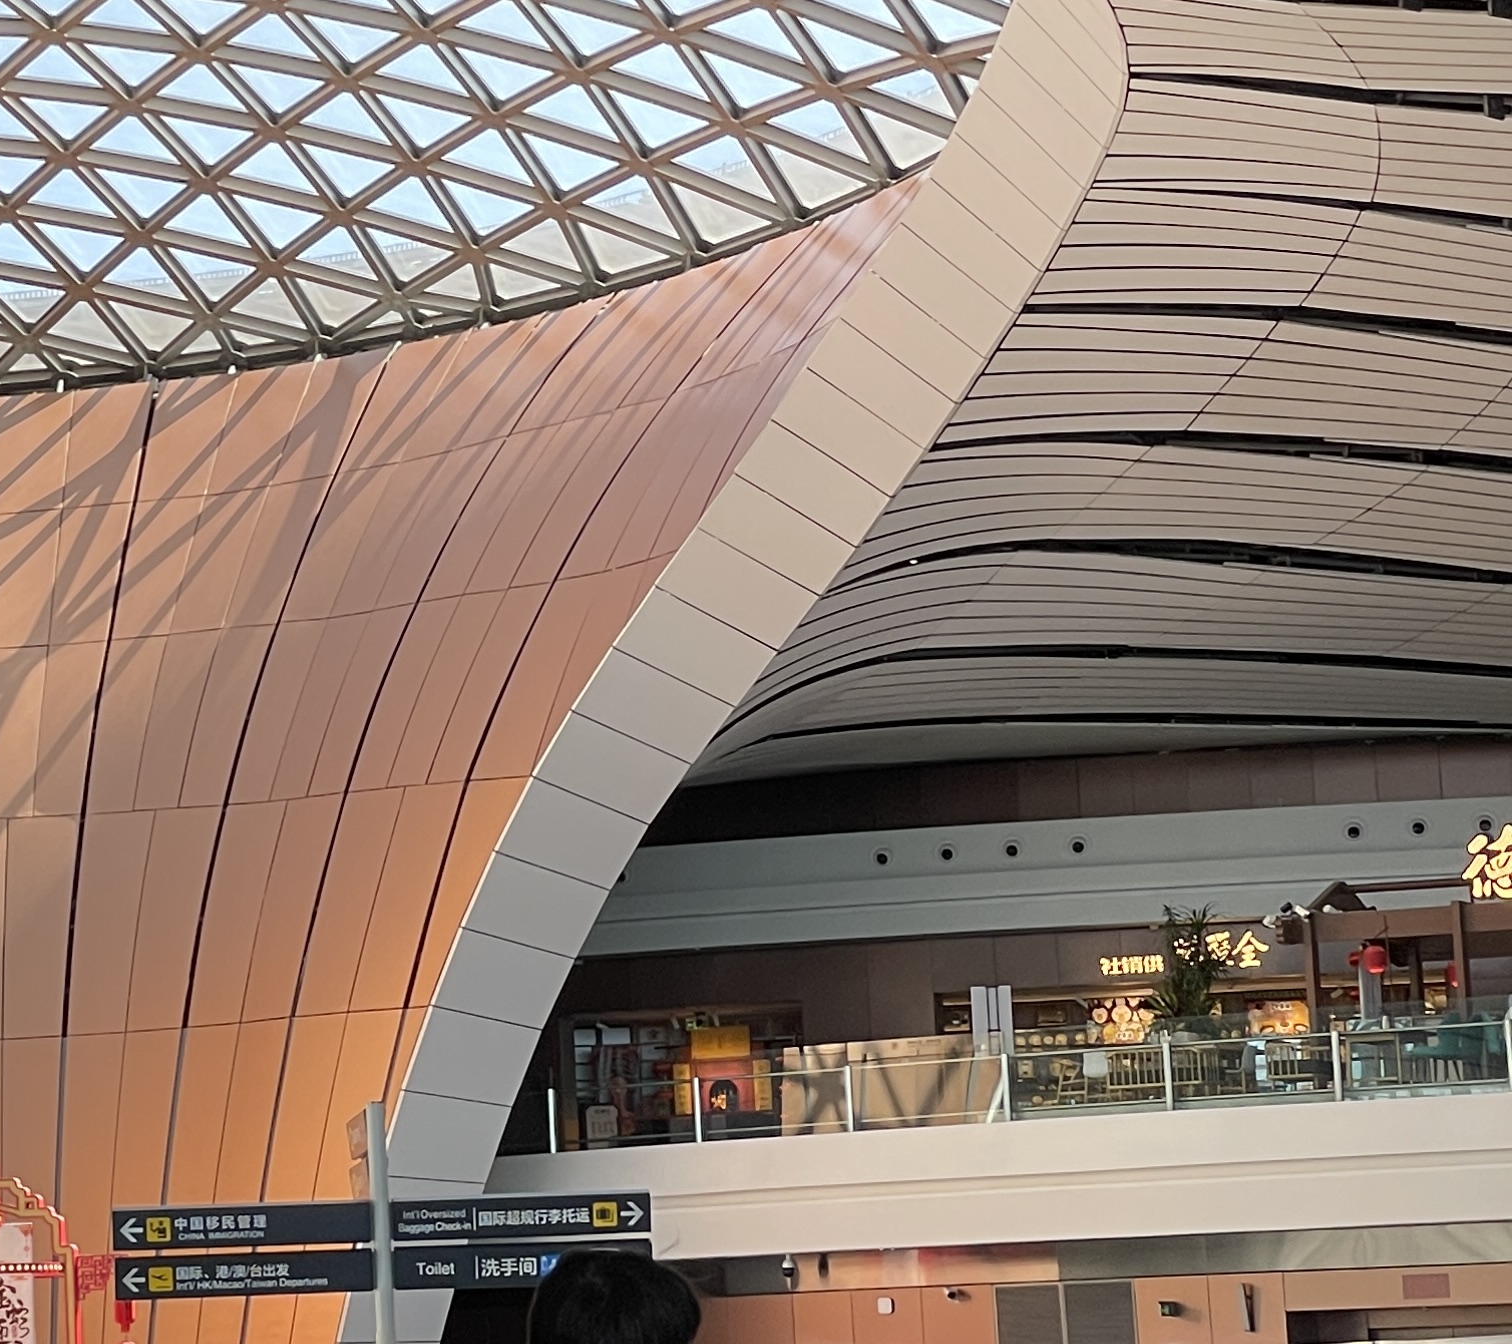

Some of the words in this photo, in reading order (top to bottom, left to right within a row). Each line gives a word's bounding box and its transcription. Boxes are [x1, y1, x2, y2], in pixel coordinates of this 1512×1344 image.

[420, 1208, 466, 1219] Oversized
[478, 1207, 591, 1227] 国际超规行李托运
[174, 1214, 267, 1231] 中国移民管理
[398, 1222, 434, 1234] Baggage
[435, 1221, 472, 1232] Check-in
[178, 1232, 205, 1241] CHINA
[208, 1230, 265, 1240] IMMIGRATION
[416, 1261, 455, 1276] Toilet
[481, 1257, 537, 1277] 洗手间
[279, 1276, 328, 1289] Departures
